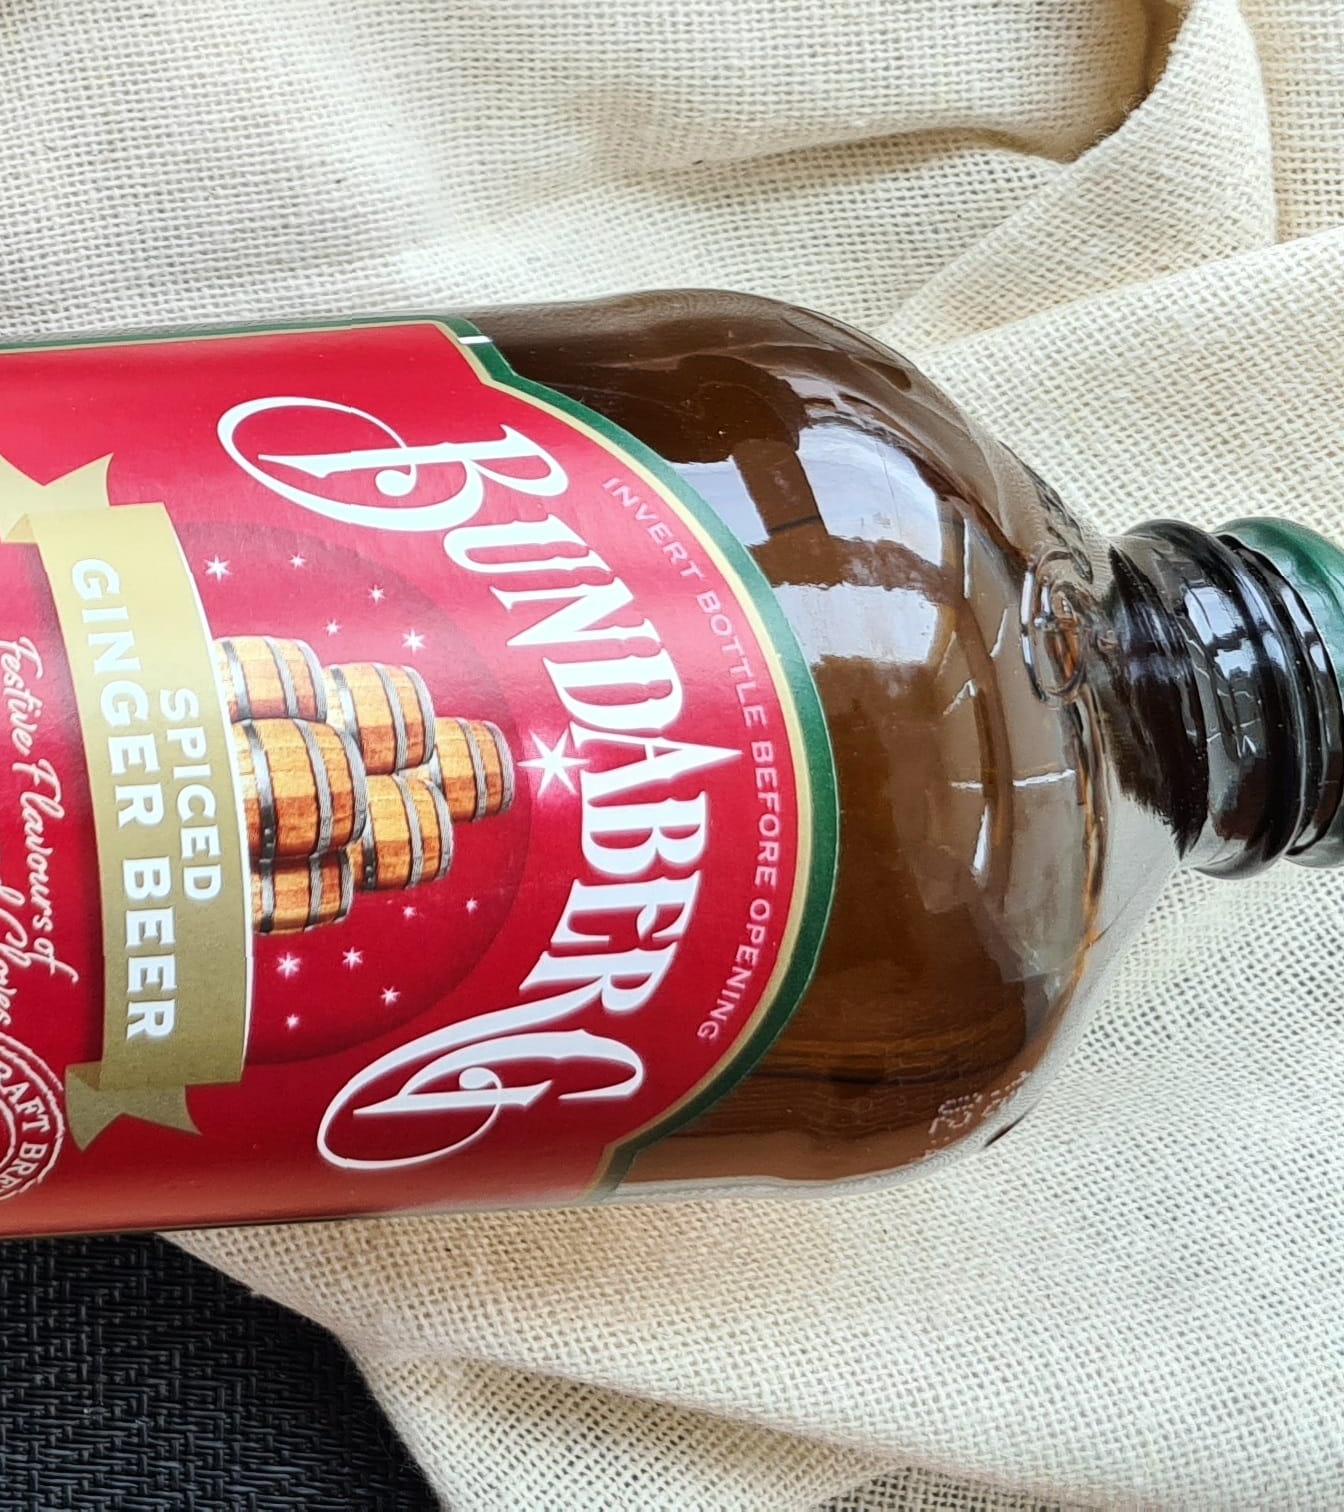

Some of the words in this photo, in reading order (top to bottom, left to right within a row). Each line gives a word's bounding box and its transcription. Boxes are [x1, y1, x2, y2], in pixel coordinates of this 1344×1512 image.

[602, 477, 704, 581] INVERT
[696, 590, 768, 731] BOTTLE
[13, 759, 65, 933] Flavours
[71, 558, 164, 829] GINGER
[122, 856, 176, 1041] BEER
[159, 688, 221, 902] SPICED
[216, 395, 743, 1170] BUNDABERG
[751, 740, 781, 888] BEFORE
[29, 936, 78, 984] of
[696, 897, 771, 1042] OPENING
